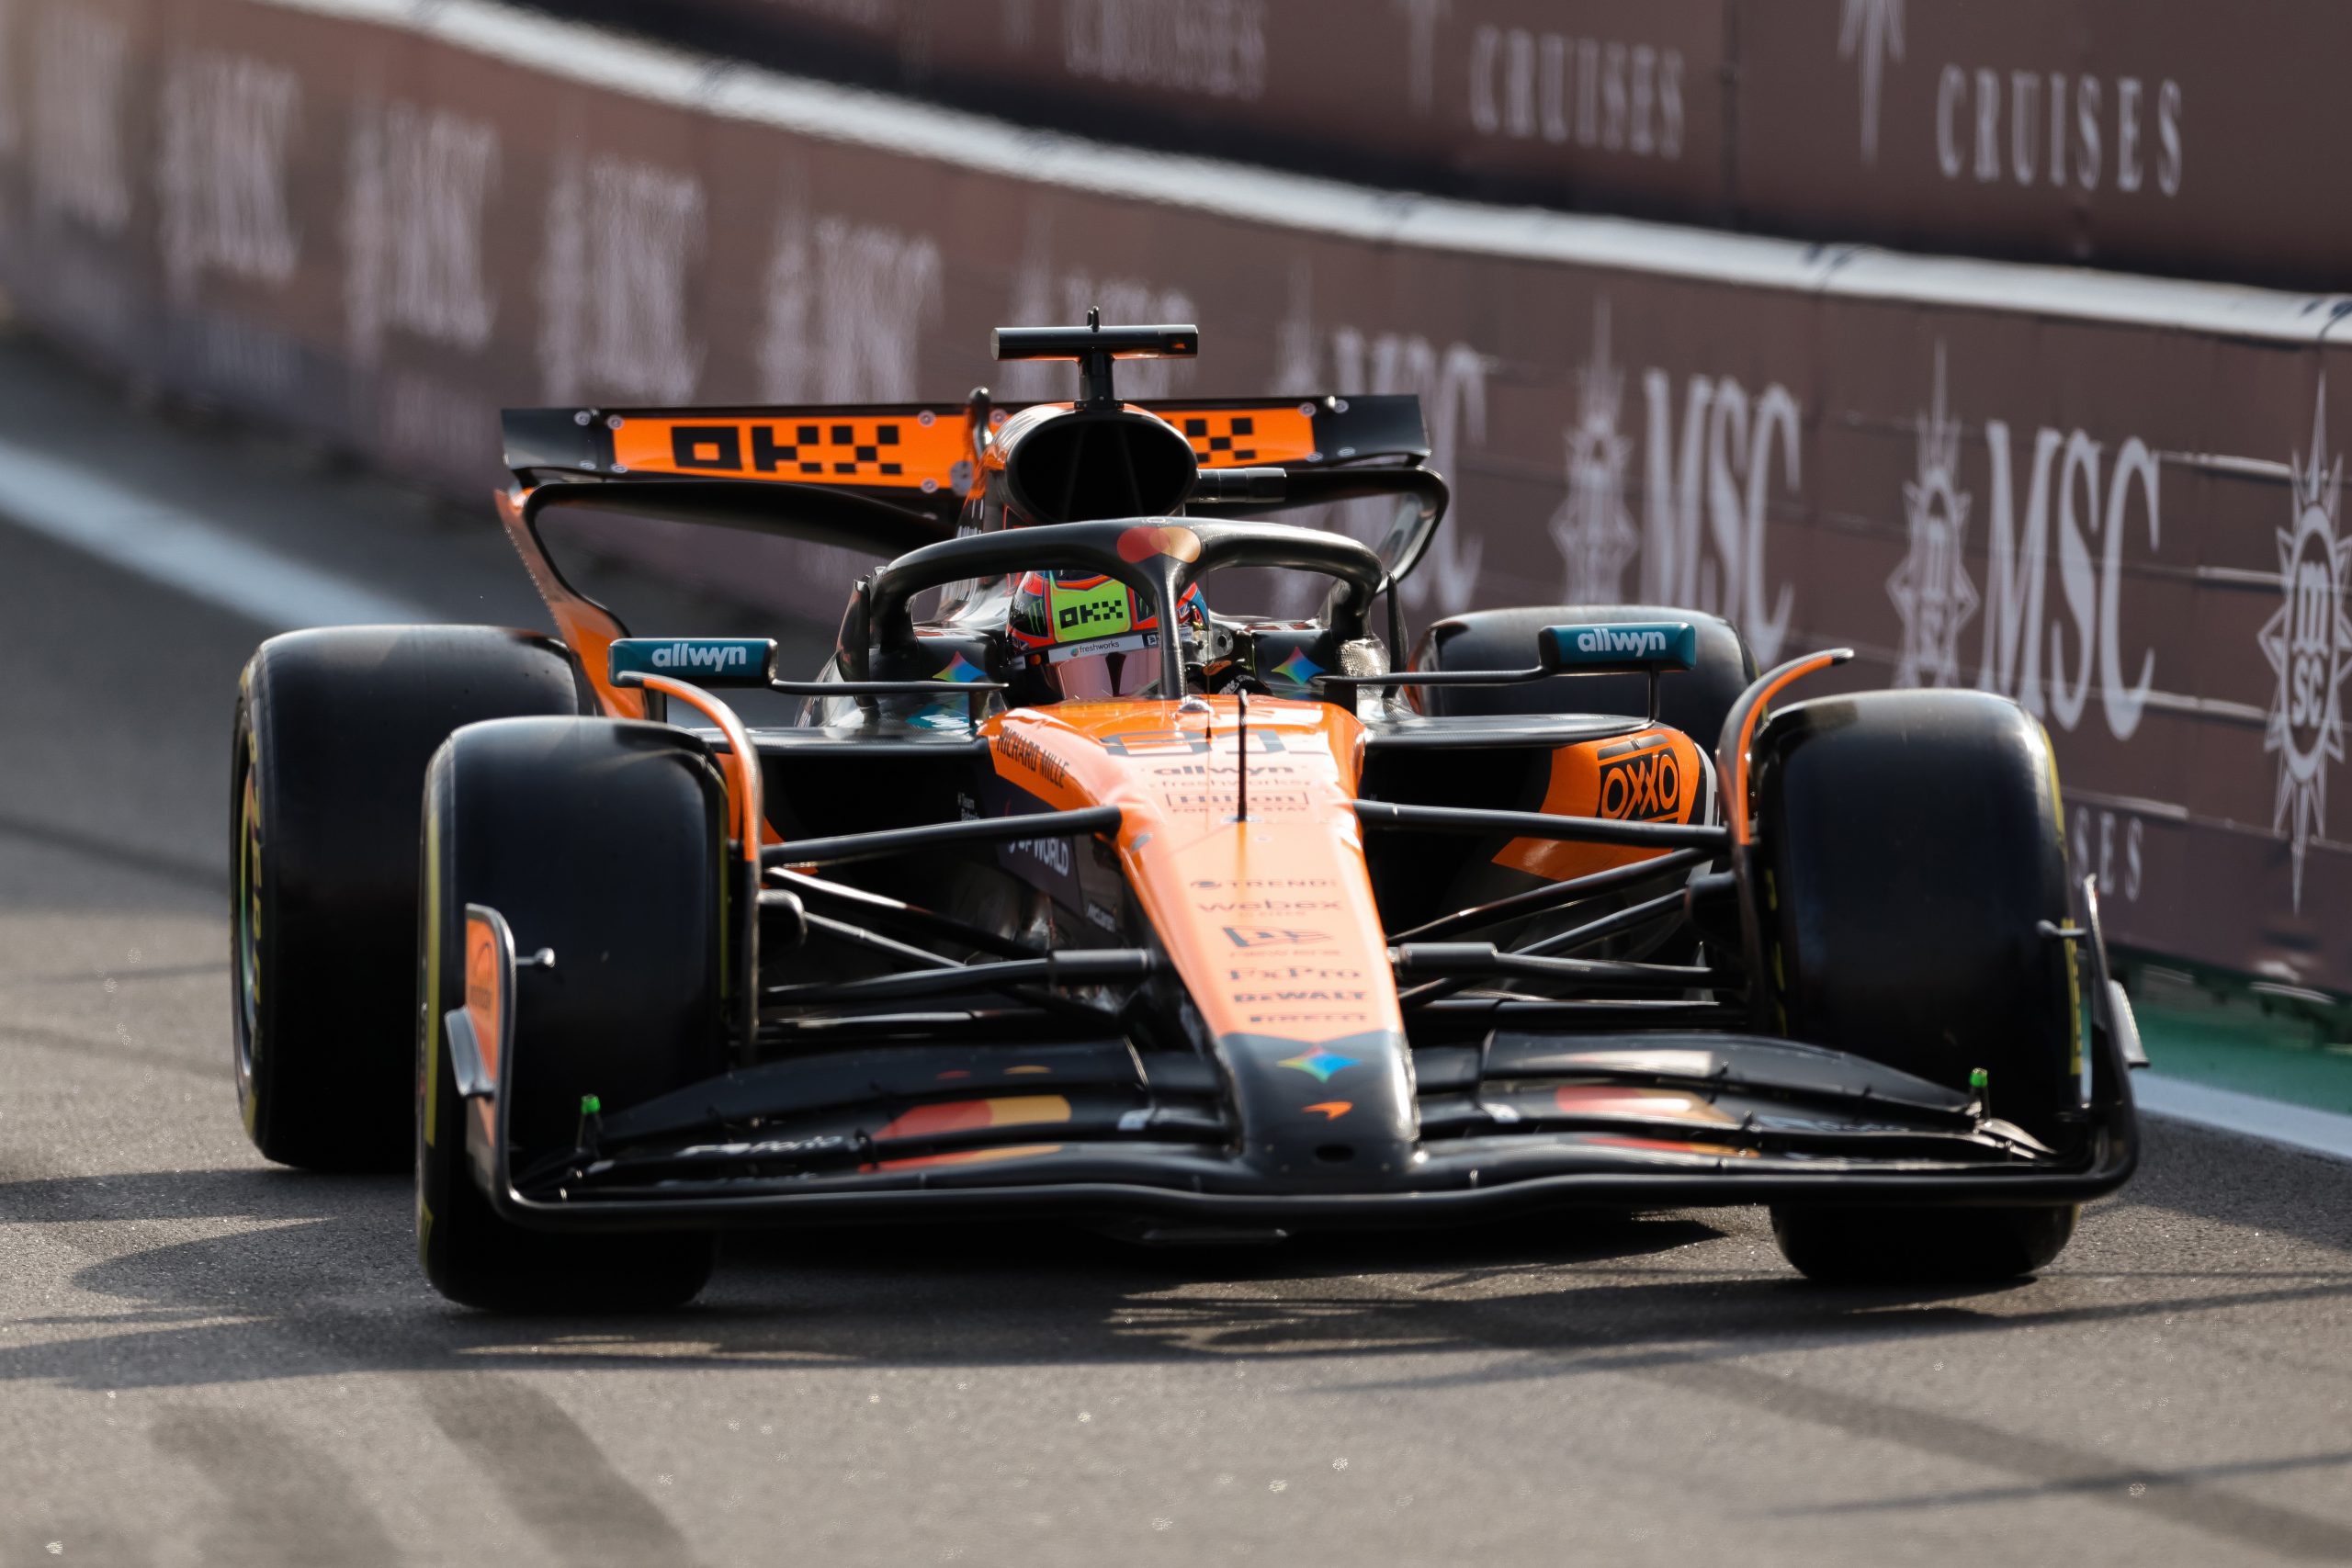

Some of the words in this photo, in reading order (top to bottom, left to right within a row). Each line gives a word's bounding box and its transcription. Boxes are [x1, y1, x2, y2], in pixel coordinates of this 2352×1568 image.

[1936, 62, 2182, 197] CRUISES
[671, 424, 902, 474] OKX
[1639, 367, 1802, 669] MSC
[1975, 419, 2161, 741] MSC
[1058, 600, 1124, 629] OKX
[1079, 640, 1120, 654] freshworks
[1577, 628, 1667, 657] allwyn
[651, 643, 746, 672] allwyn
[997, 727, 1040, 773] RICHARD
[1040, 748, 1070, 789] MILLE
[1153, 765, 1295, 776] allwyn
[1601, 754, 1679, 820] OXXO
[1198, 899, 1343, 912] webex
[1228, 966, 1362, 981] FxPro
